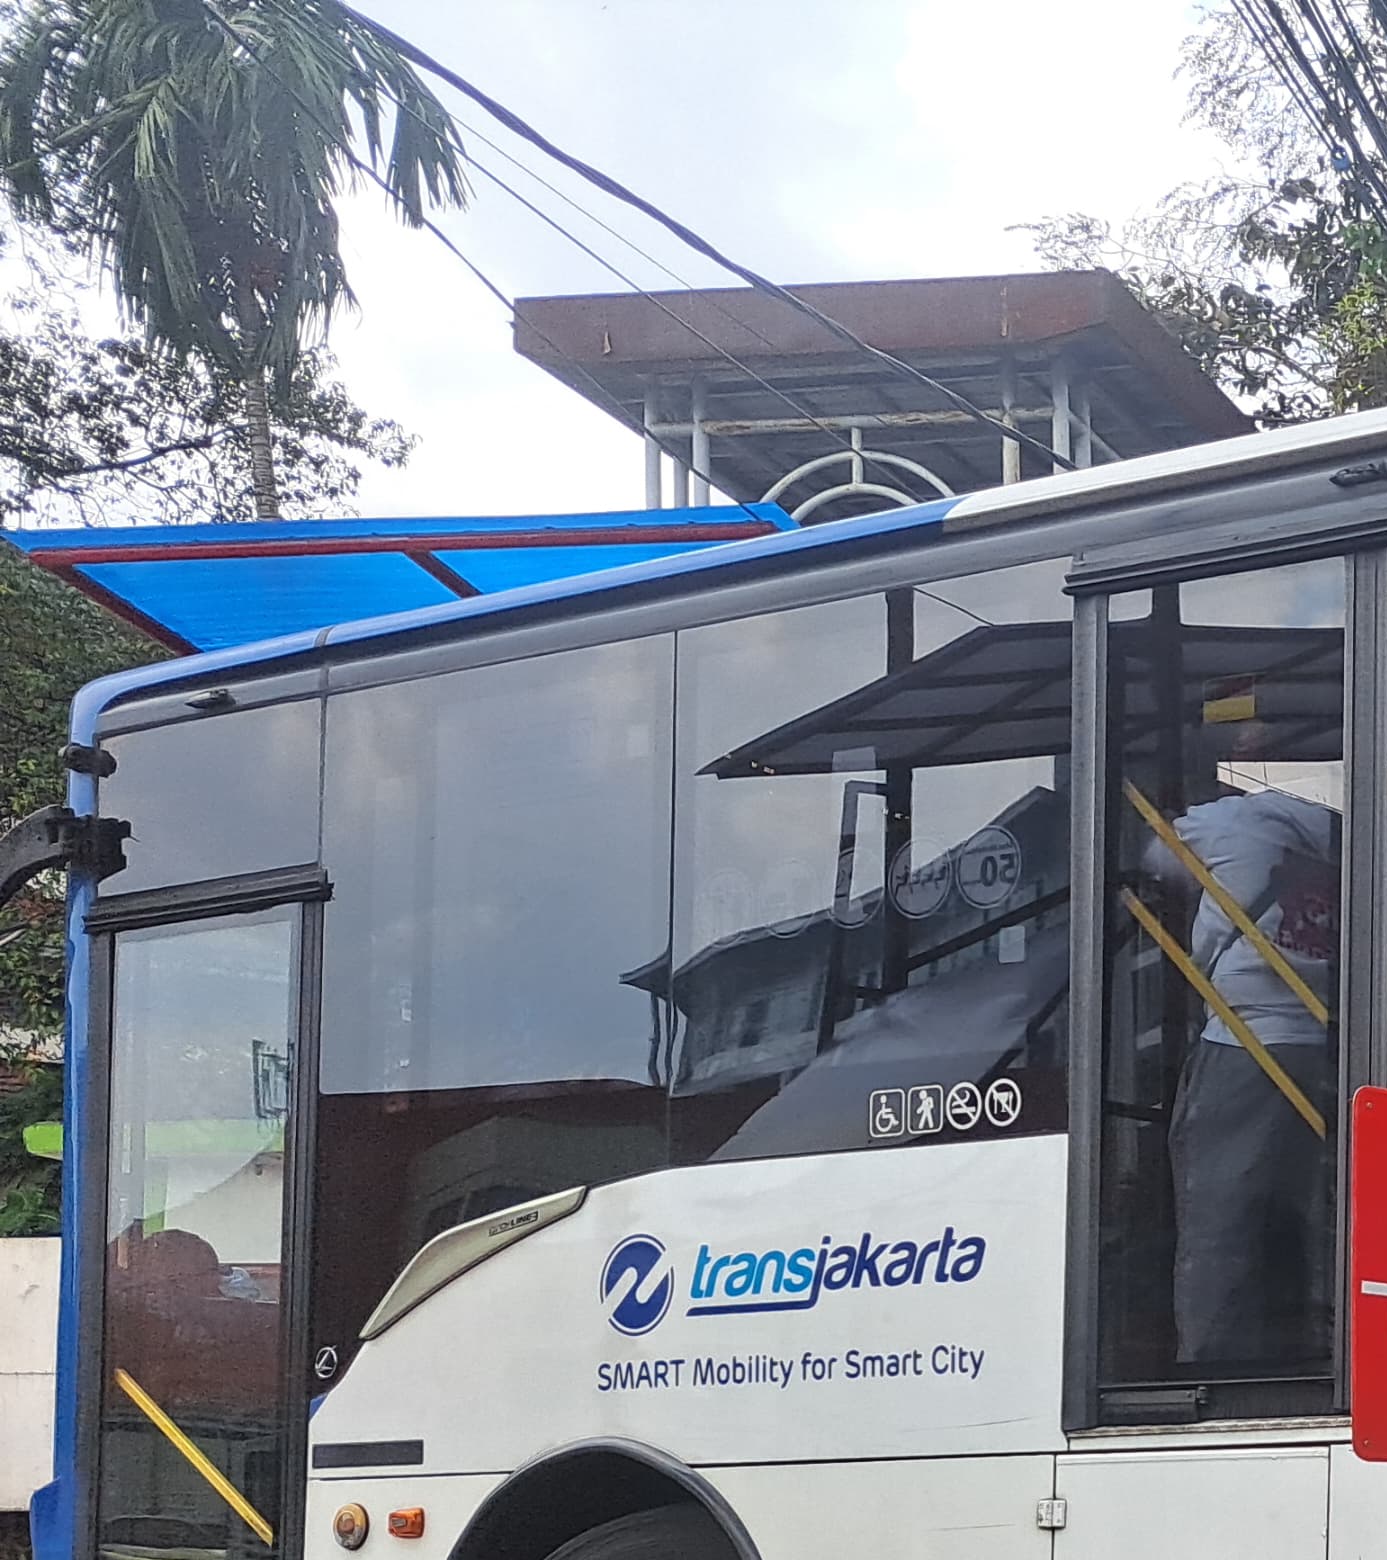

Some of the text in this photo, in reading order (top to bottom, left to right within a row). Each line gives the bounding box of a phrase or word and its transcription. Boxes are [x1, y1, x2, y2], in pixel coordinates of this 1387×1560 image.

[687, 1226, 987, 1316] transjakarta
[597, 1344, 985, 1391] SMART Mobility for Smart City
